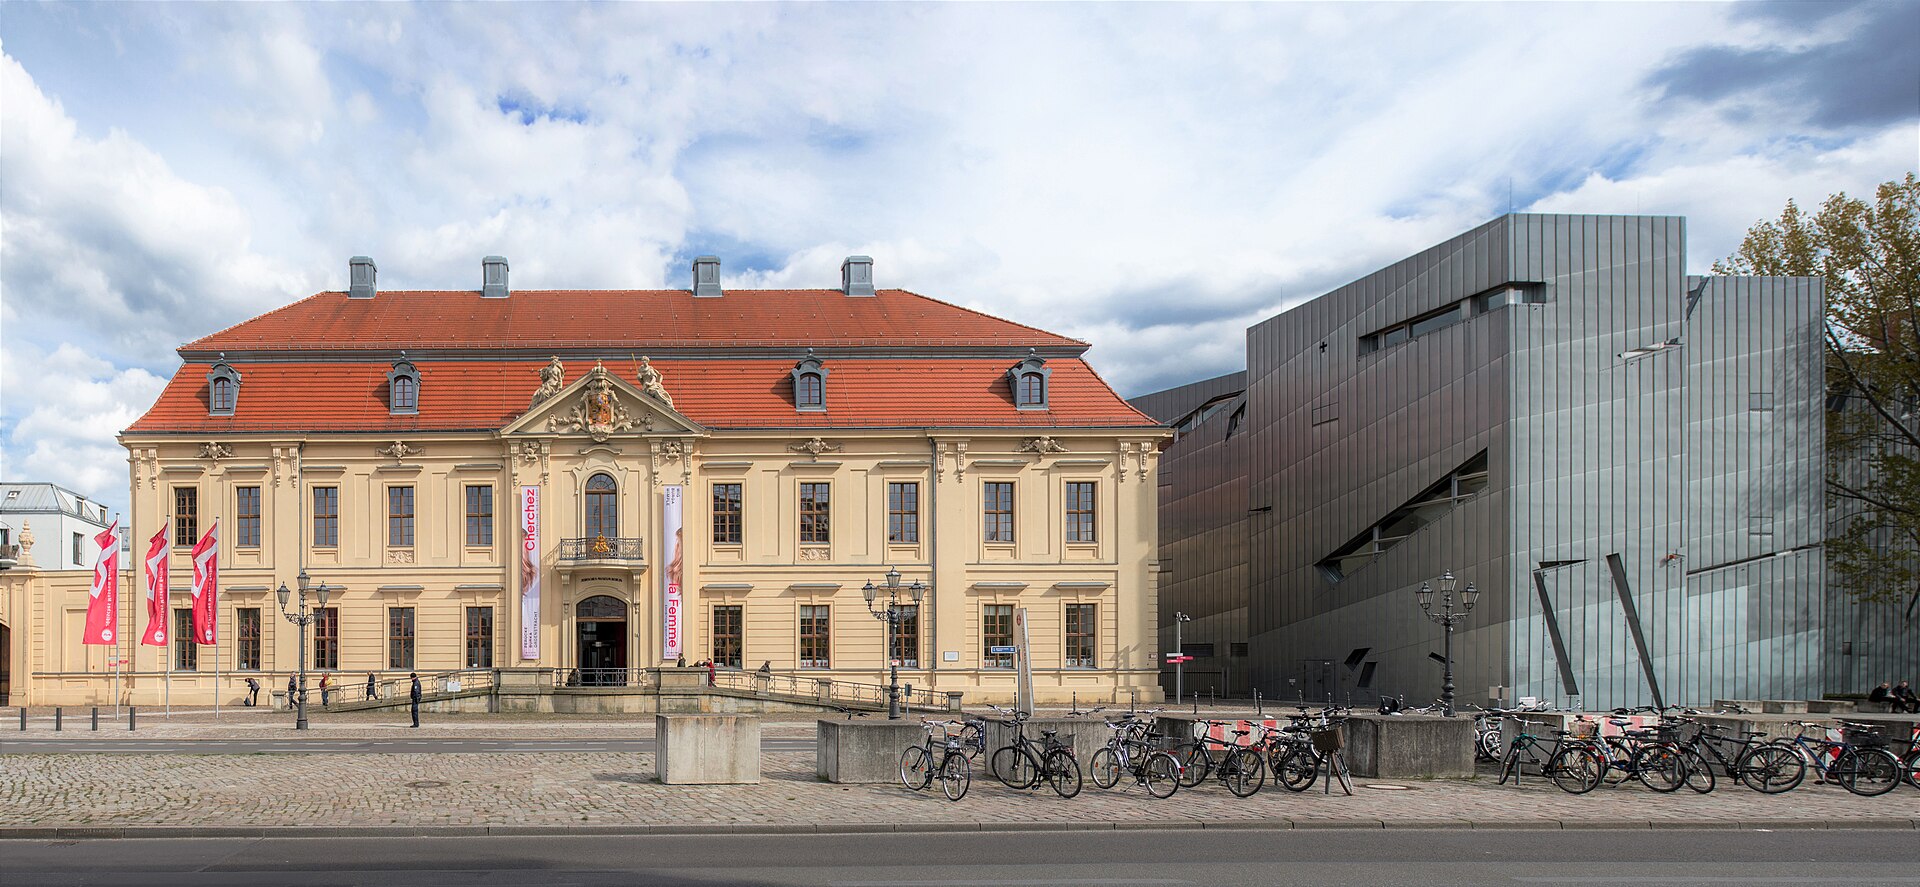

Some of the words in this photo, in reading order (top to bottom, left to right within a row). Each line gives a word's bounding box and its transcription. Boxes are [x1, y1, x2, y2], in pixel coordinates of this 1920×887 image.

[524, 488, 535, 551] Cherchez
[668, 583, 681, 594] la
[668, 599, 679, 648] Femme
